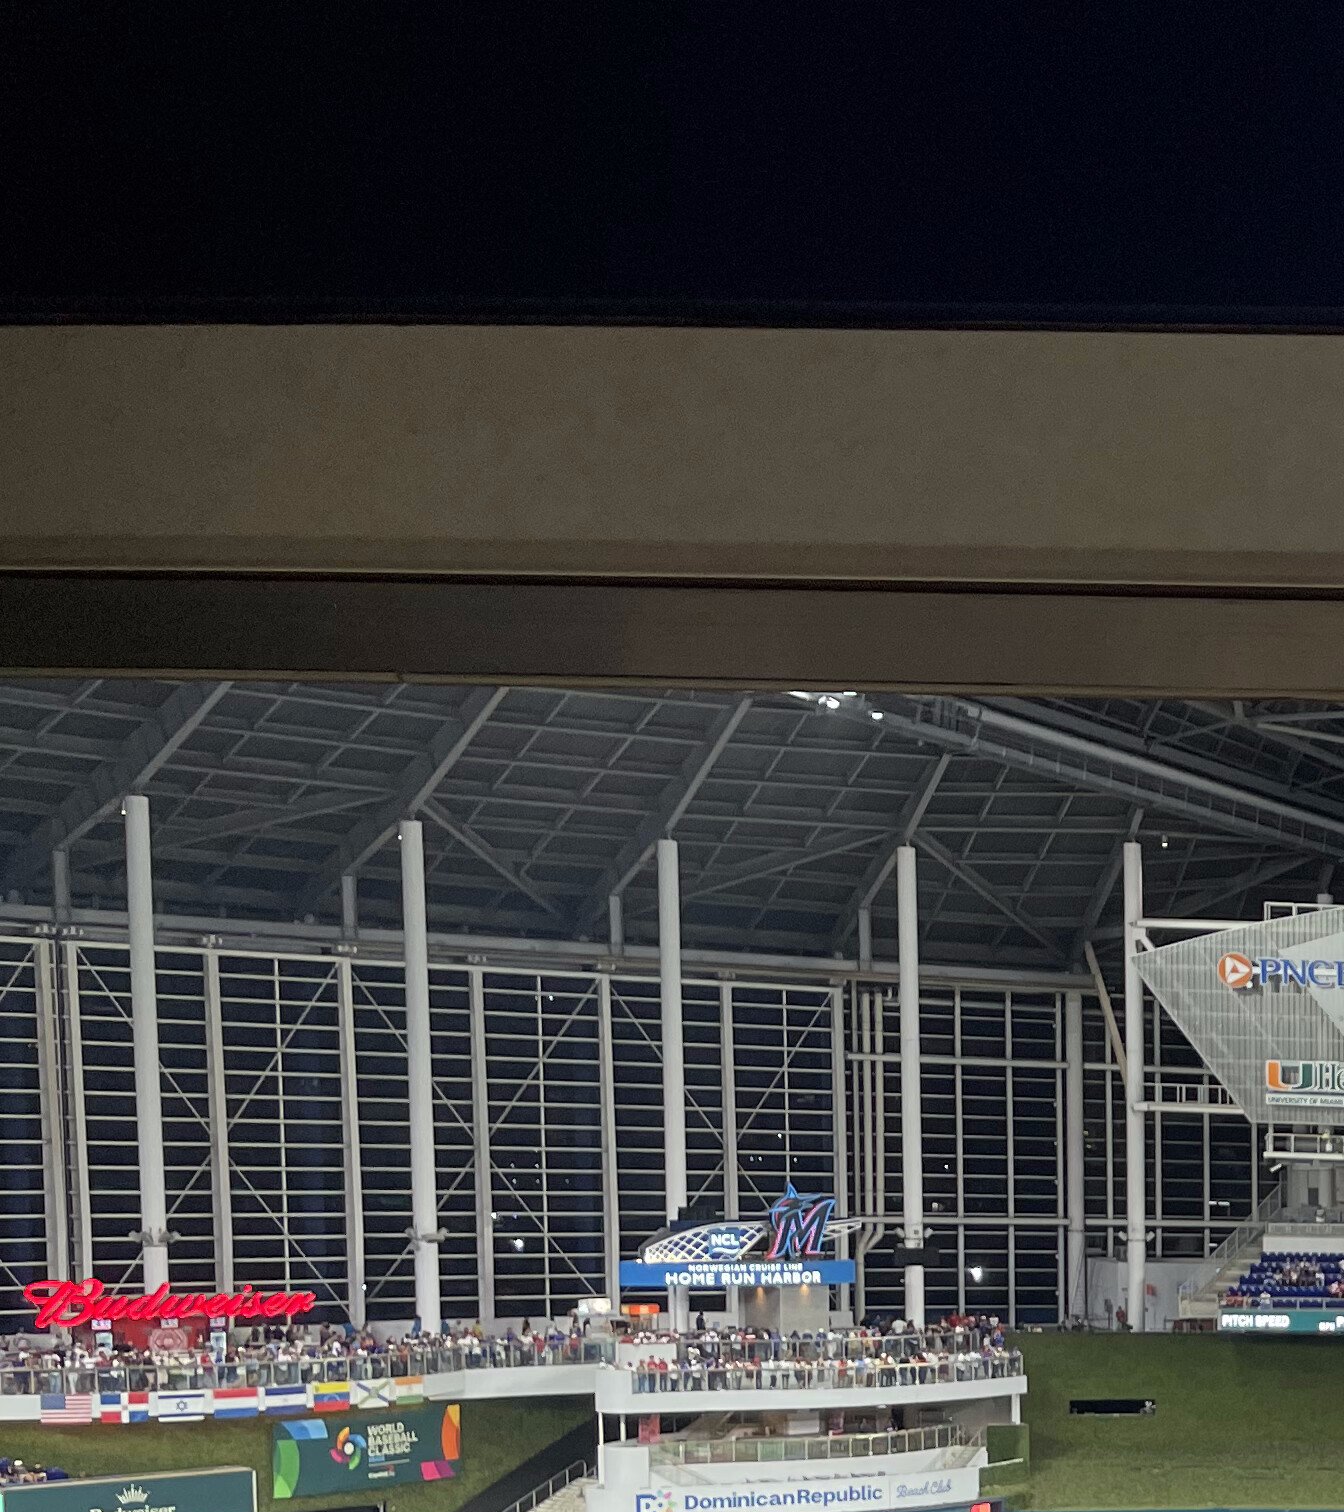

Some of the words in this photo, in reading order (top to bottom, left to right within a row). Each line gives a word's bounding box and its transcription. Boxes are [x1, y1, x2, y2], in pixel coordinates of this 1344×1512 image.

[711, 1233, 739, 1246] NCL
[665, 1271, 716, 1286] HOME
[721, 1271, 755, 1285] RUN
[761, 1270, 821, 1285] HARBOR
[23, 1277, 316, 1328] Budweiser
[1222, 1315, 1254, 1328] PITCH
[367, 1421, 405, 1435] WORLD
[367, 1431, 419, 1448] BASEBALL
[367, 1442, 412, 1457] CLASSIC
